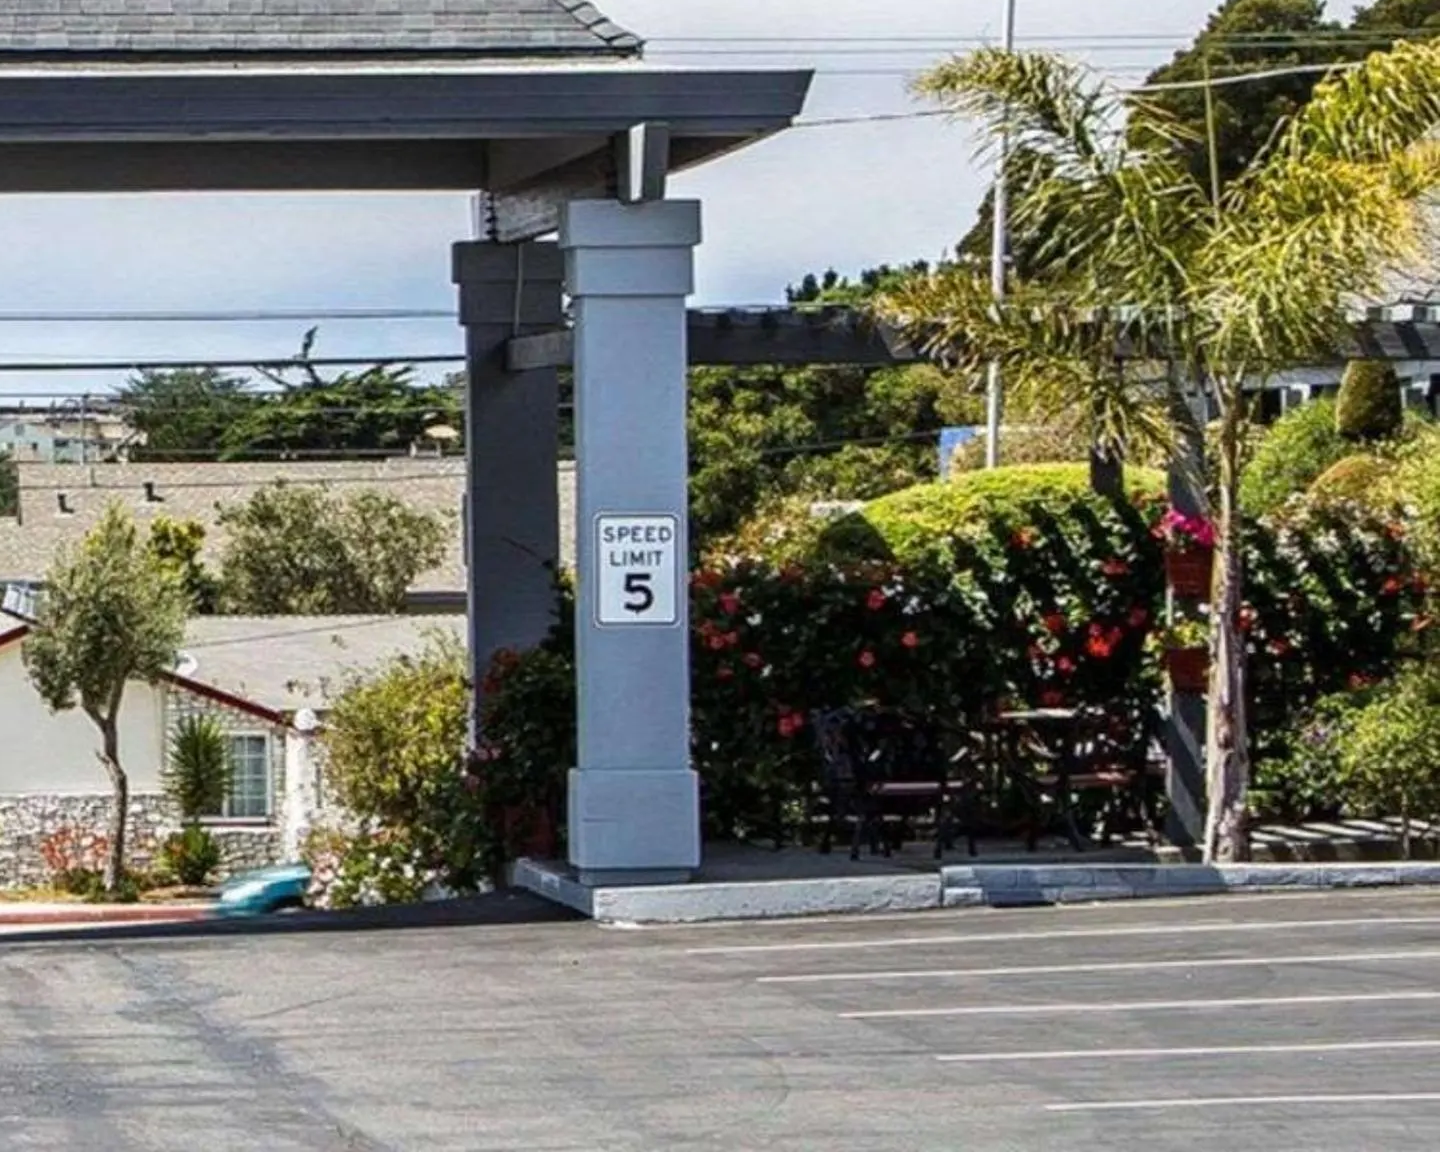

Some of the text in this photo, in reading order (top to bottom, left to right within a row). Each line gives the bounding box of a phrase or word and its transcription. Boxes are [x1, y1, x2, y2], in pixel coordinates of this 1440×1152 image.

[603, 526, 672, 543] SPEED
[609, 550, 664, 567] LIMIT
[623, 573, 655, 613] 5
